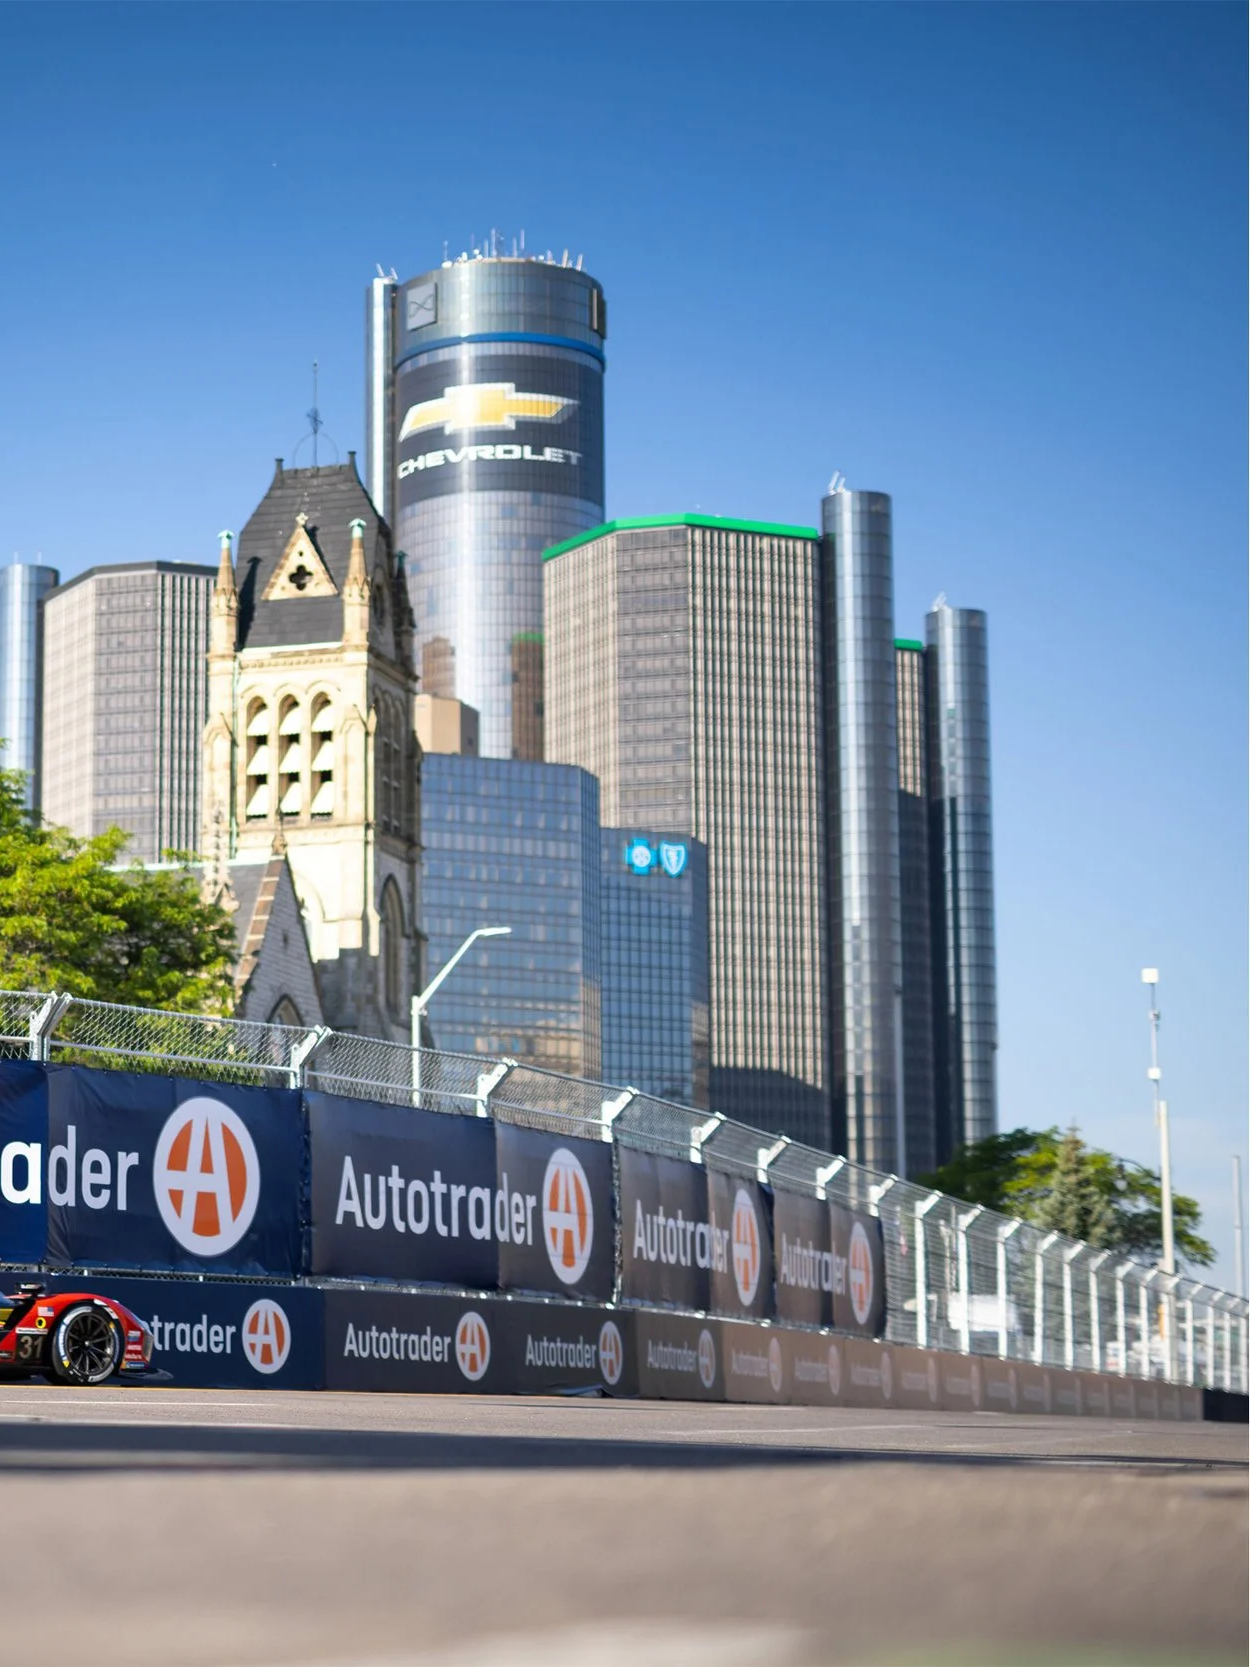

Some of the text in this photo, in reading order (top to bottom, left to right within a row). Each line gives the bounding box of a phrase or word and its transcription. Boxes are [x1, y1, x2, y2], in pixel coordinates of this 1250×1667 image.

[397, 444, 583, 480] CHEVROLET
[336, 1156, 537, 1245] Autotrader
[19, 1335, 44, 1359] 31
[142, 1314, 237, 1354] trader
[343, 1322, 451, 1363] Autotrader
[525, 1334, 597, 1369] Autotrader
[647, 1339, 697, 1372] Autotrader
